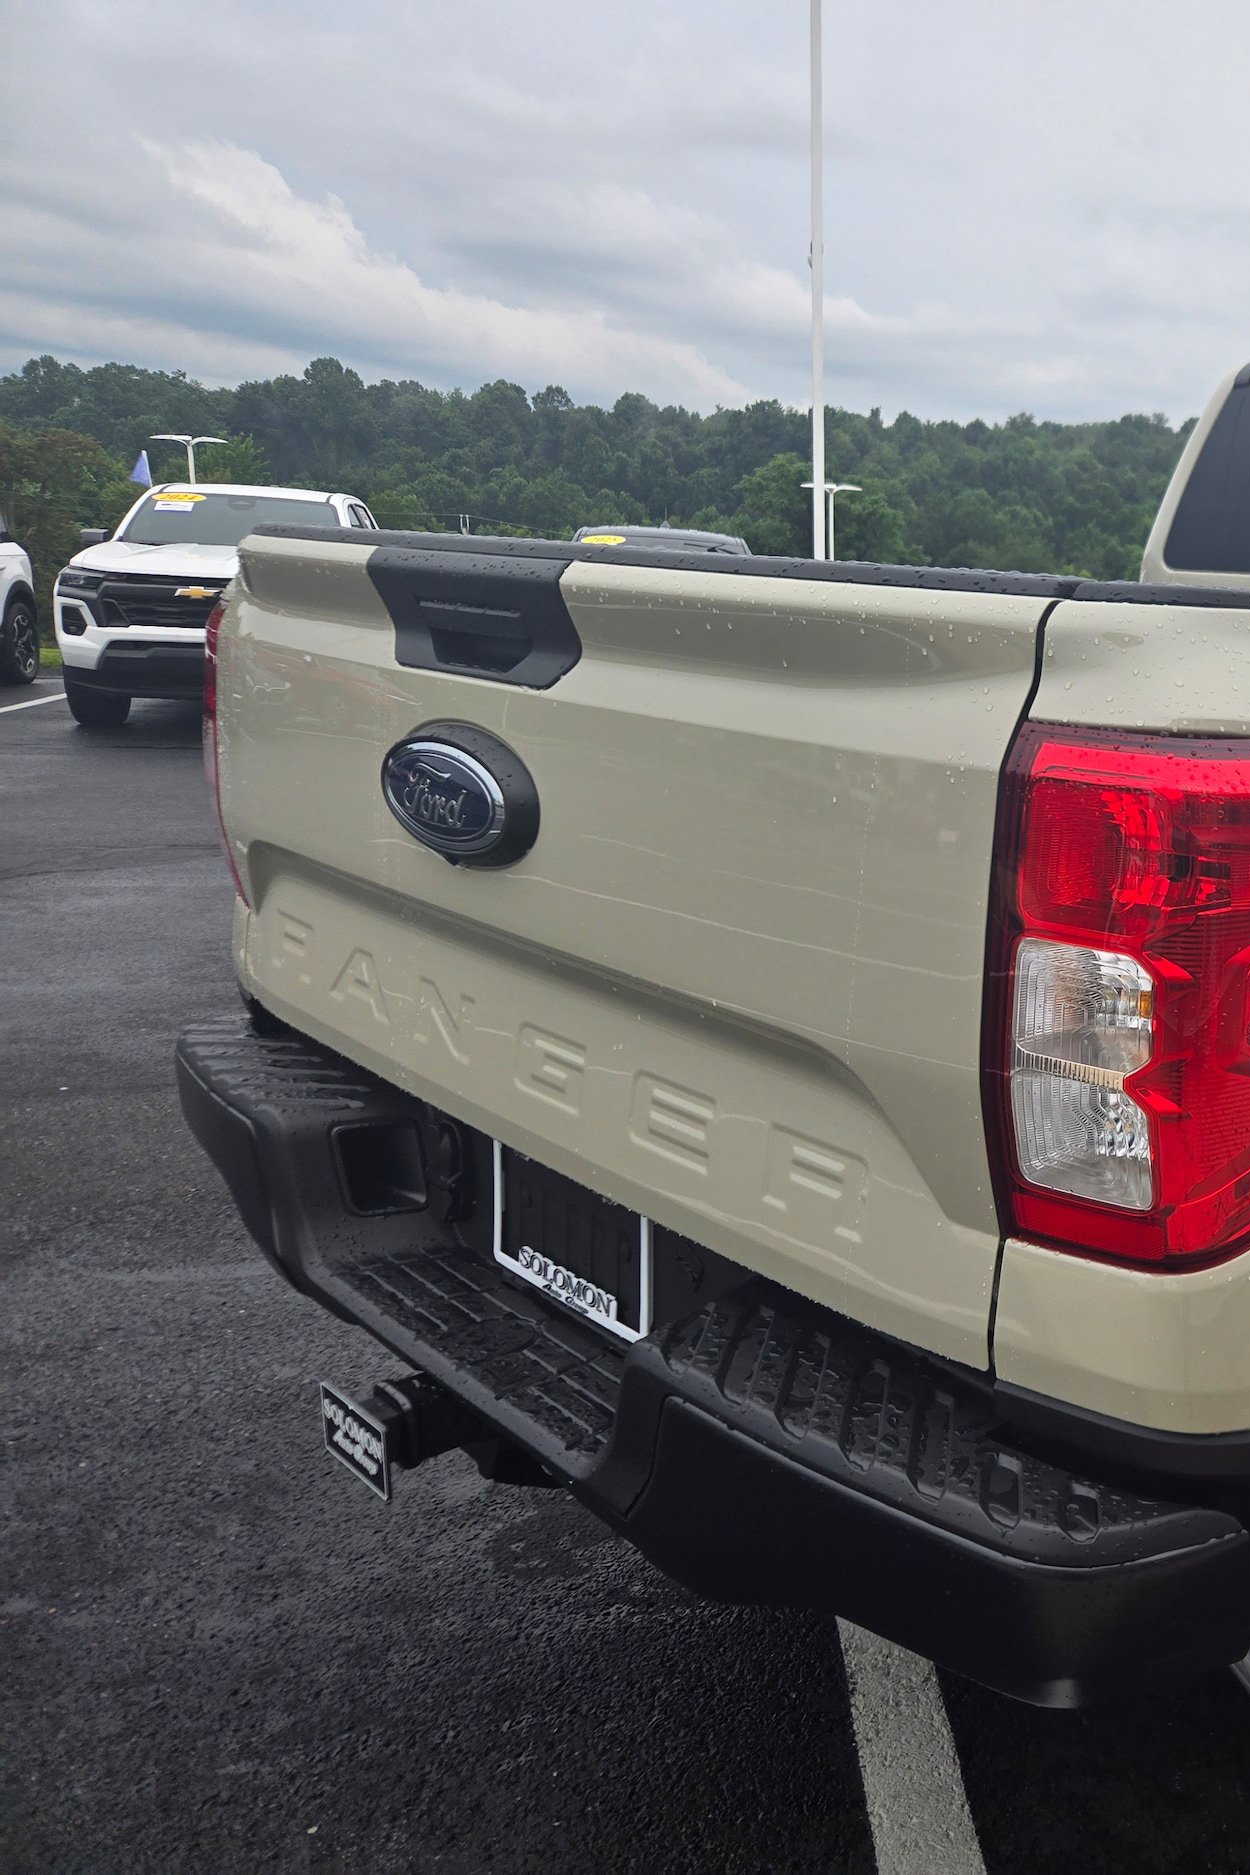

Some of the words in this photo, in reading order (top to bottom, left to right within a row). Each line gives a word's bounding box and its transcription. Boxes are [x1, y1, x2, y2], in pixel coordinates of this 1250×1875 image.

[403, 762, 468, 828] Ford
[268, 906, 869, 1244] RANGER
[518, 1247, 615, 1318] SOLOMON
[542, 1283, 562, 1299] Auto
[323, 1398, 384, 1464] SOLOMON
